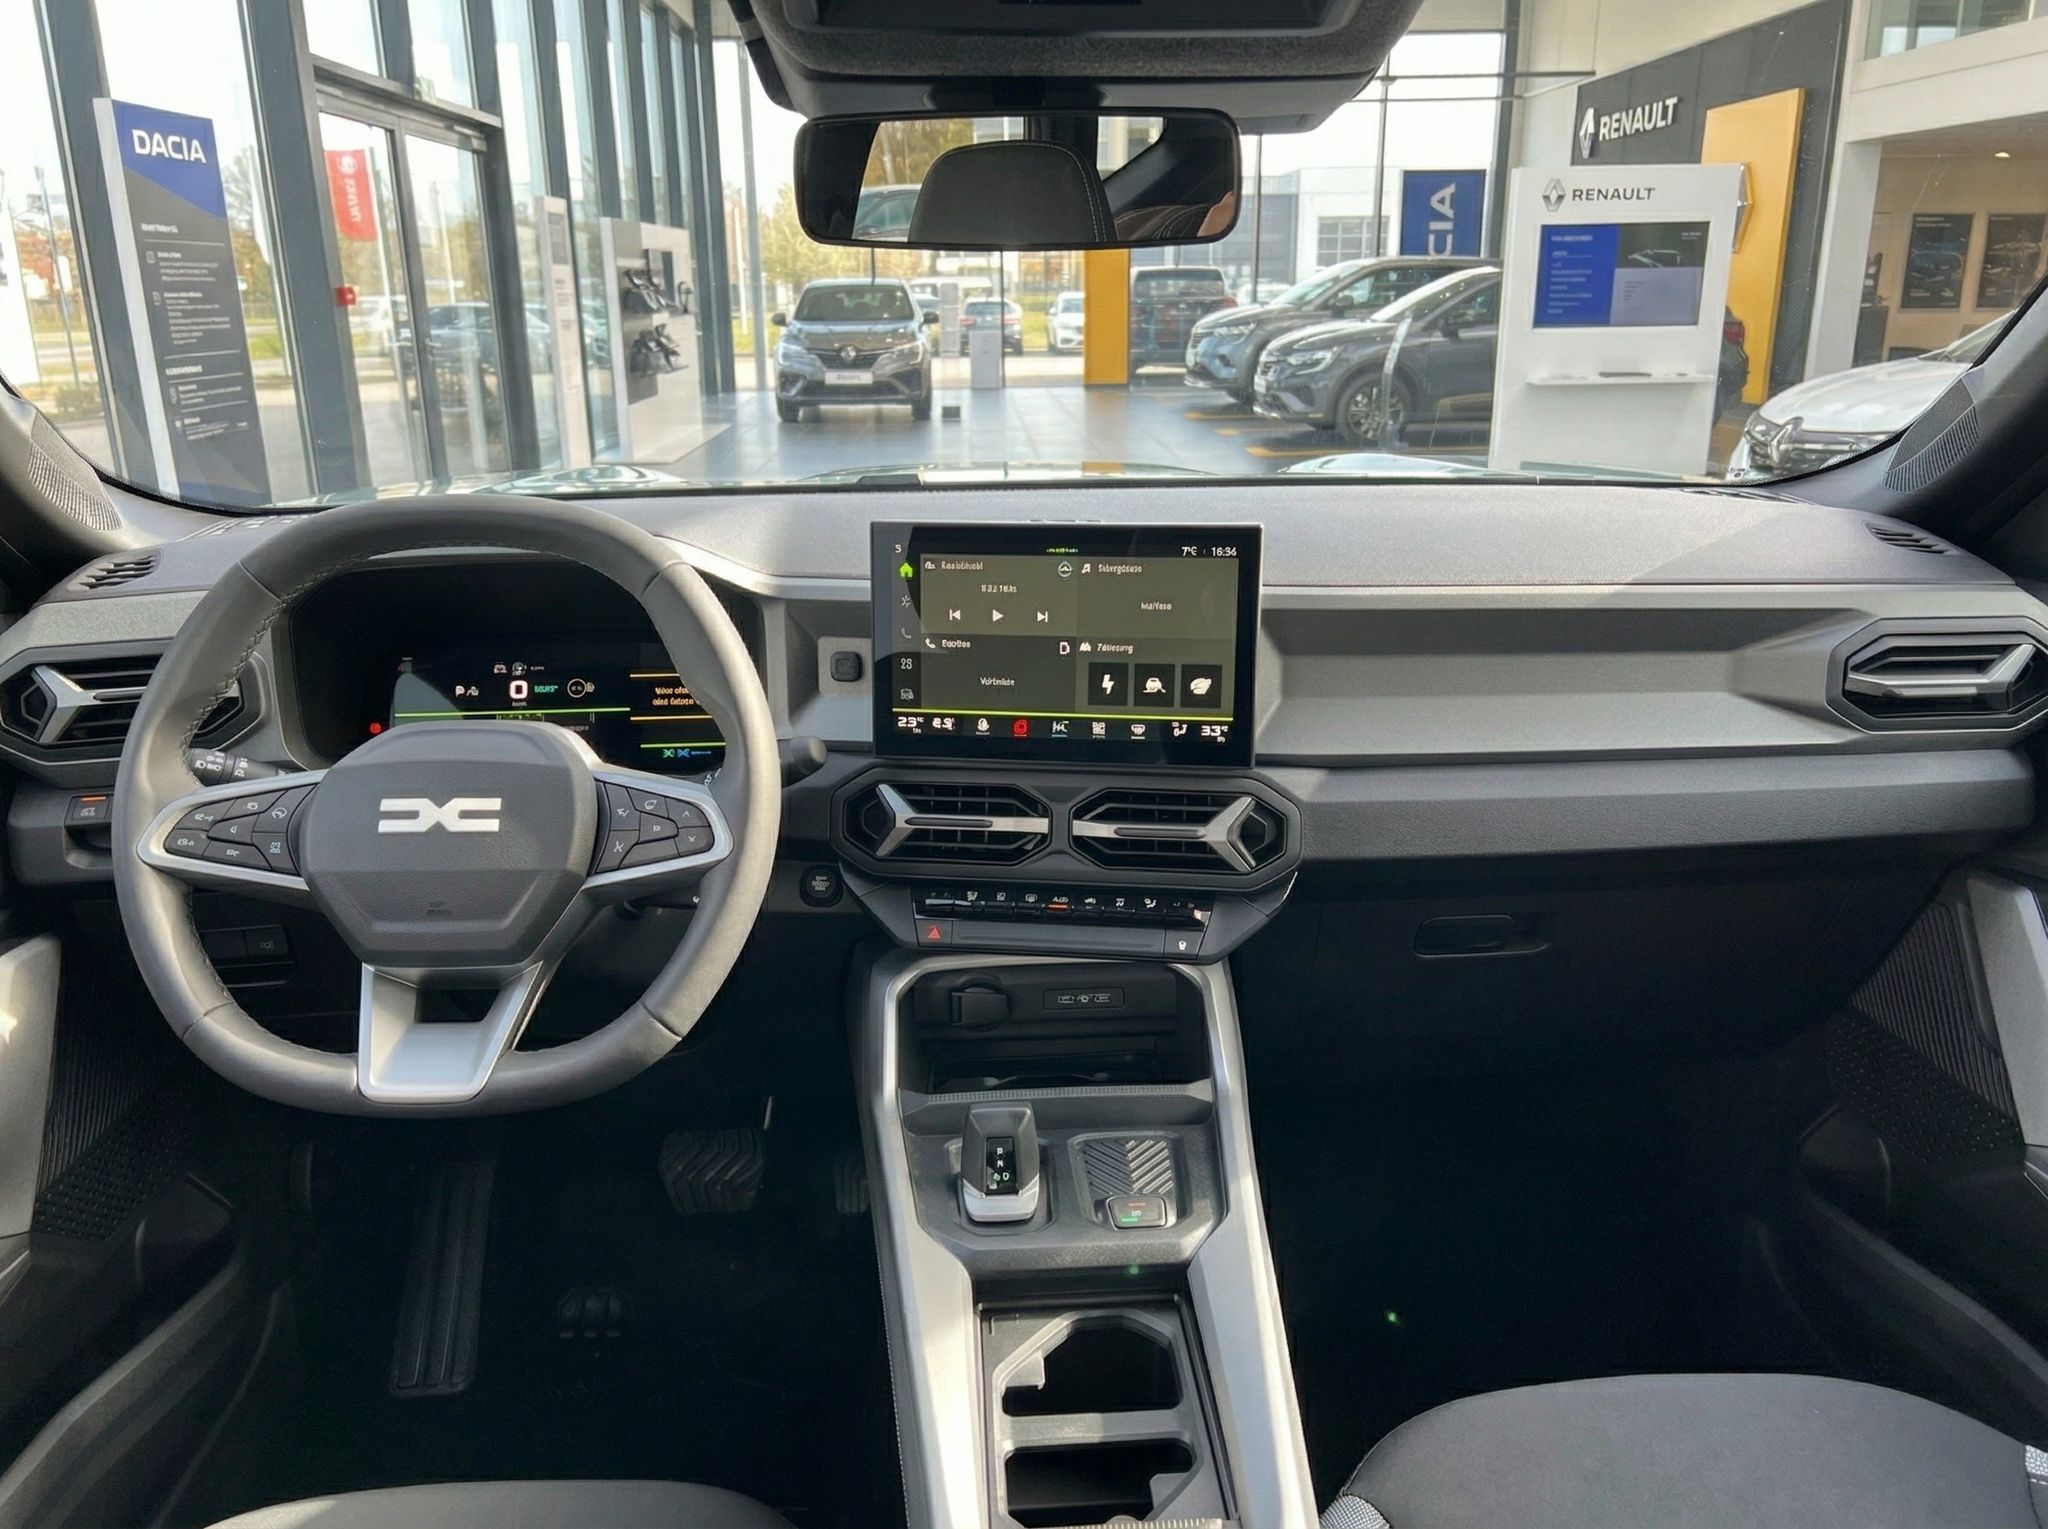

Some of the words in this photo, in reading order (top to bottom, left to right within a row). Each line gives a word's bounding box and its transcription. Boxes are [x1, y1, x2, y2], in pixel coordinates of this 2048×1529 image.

[1598, 96, 1678, 142] RENAULT
[131, 128, 207, 164] DACIA
[1571, 187, 1656, 202] RENAULT
